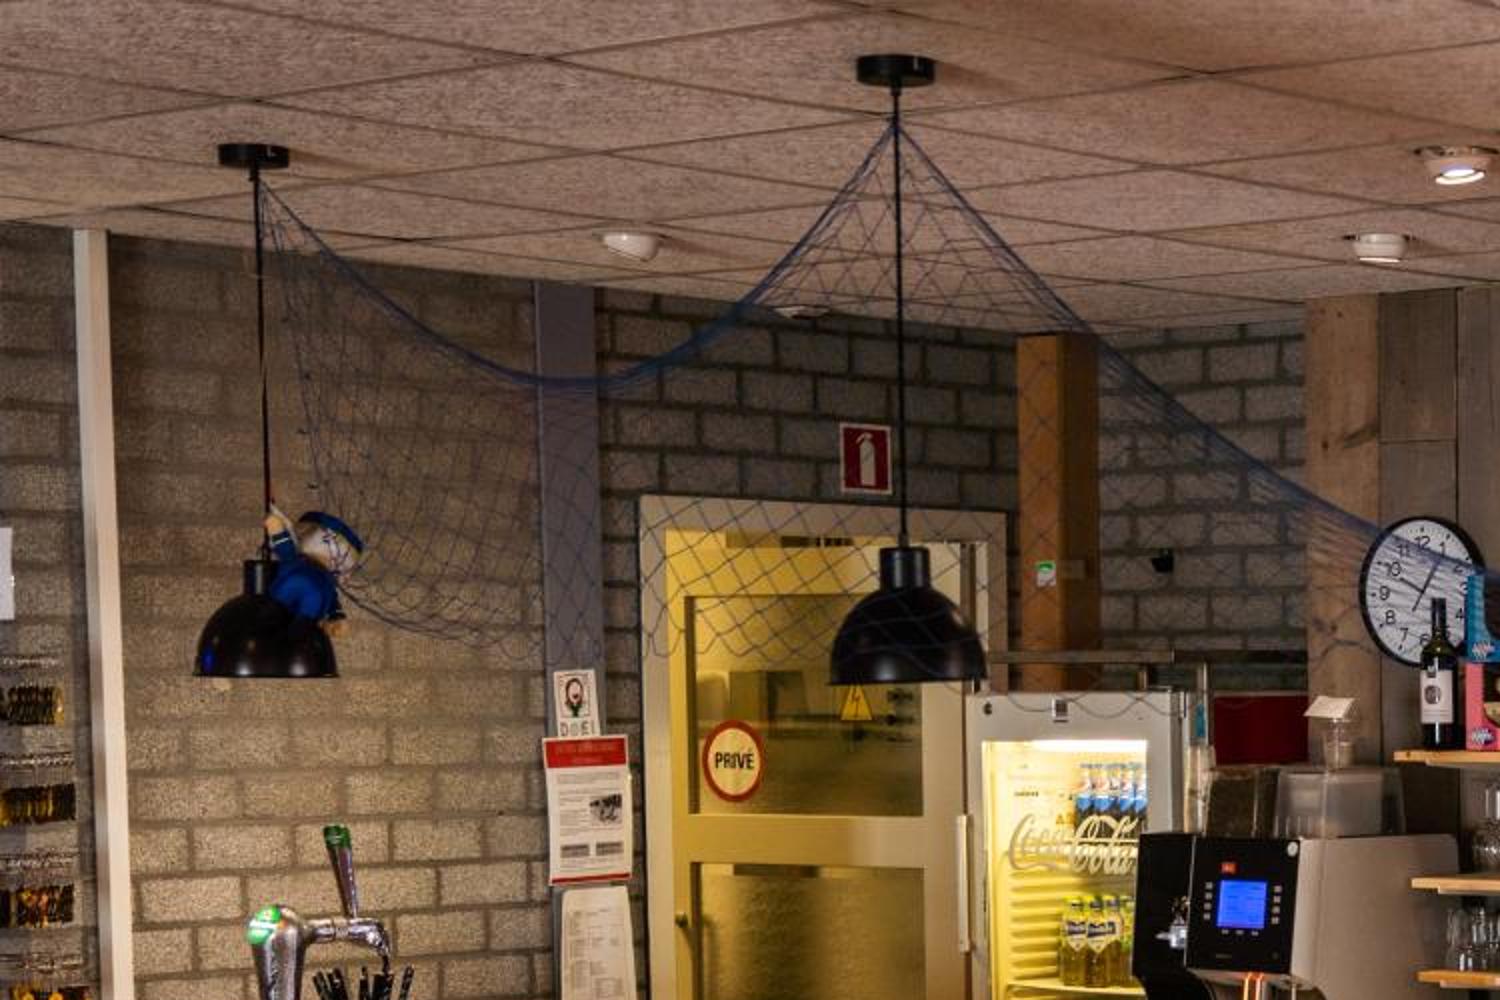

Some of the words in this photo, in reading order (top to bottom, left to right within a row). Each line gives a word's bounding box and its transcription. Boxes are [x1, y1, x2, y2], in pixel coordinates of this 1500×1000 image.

[1415, 535, 1431, 552] 12
[1440, 541, 1446, 558] 1
[1384, 561, 1401, 577] 10
[1380, 585, 1390, 601] 9
[1385, 609, 1396, 625] 8
[1399, 627, 1409, 642] 7
